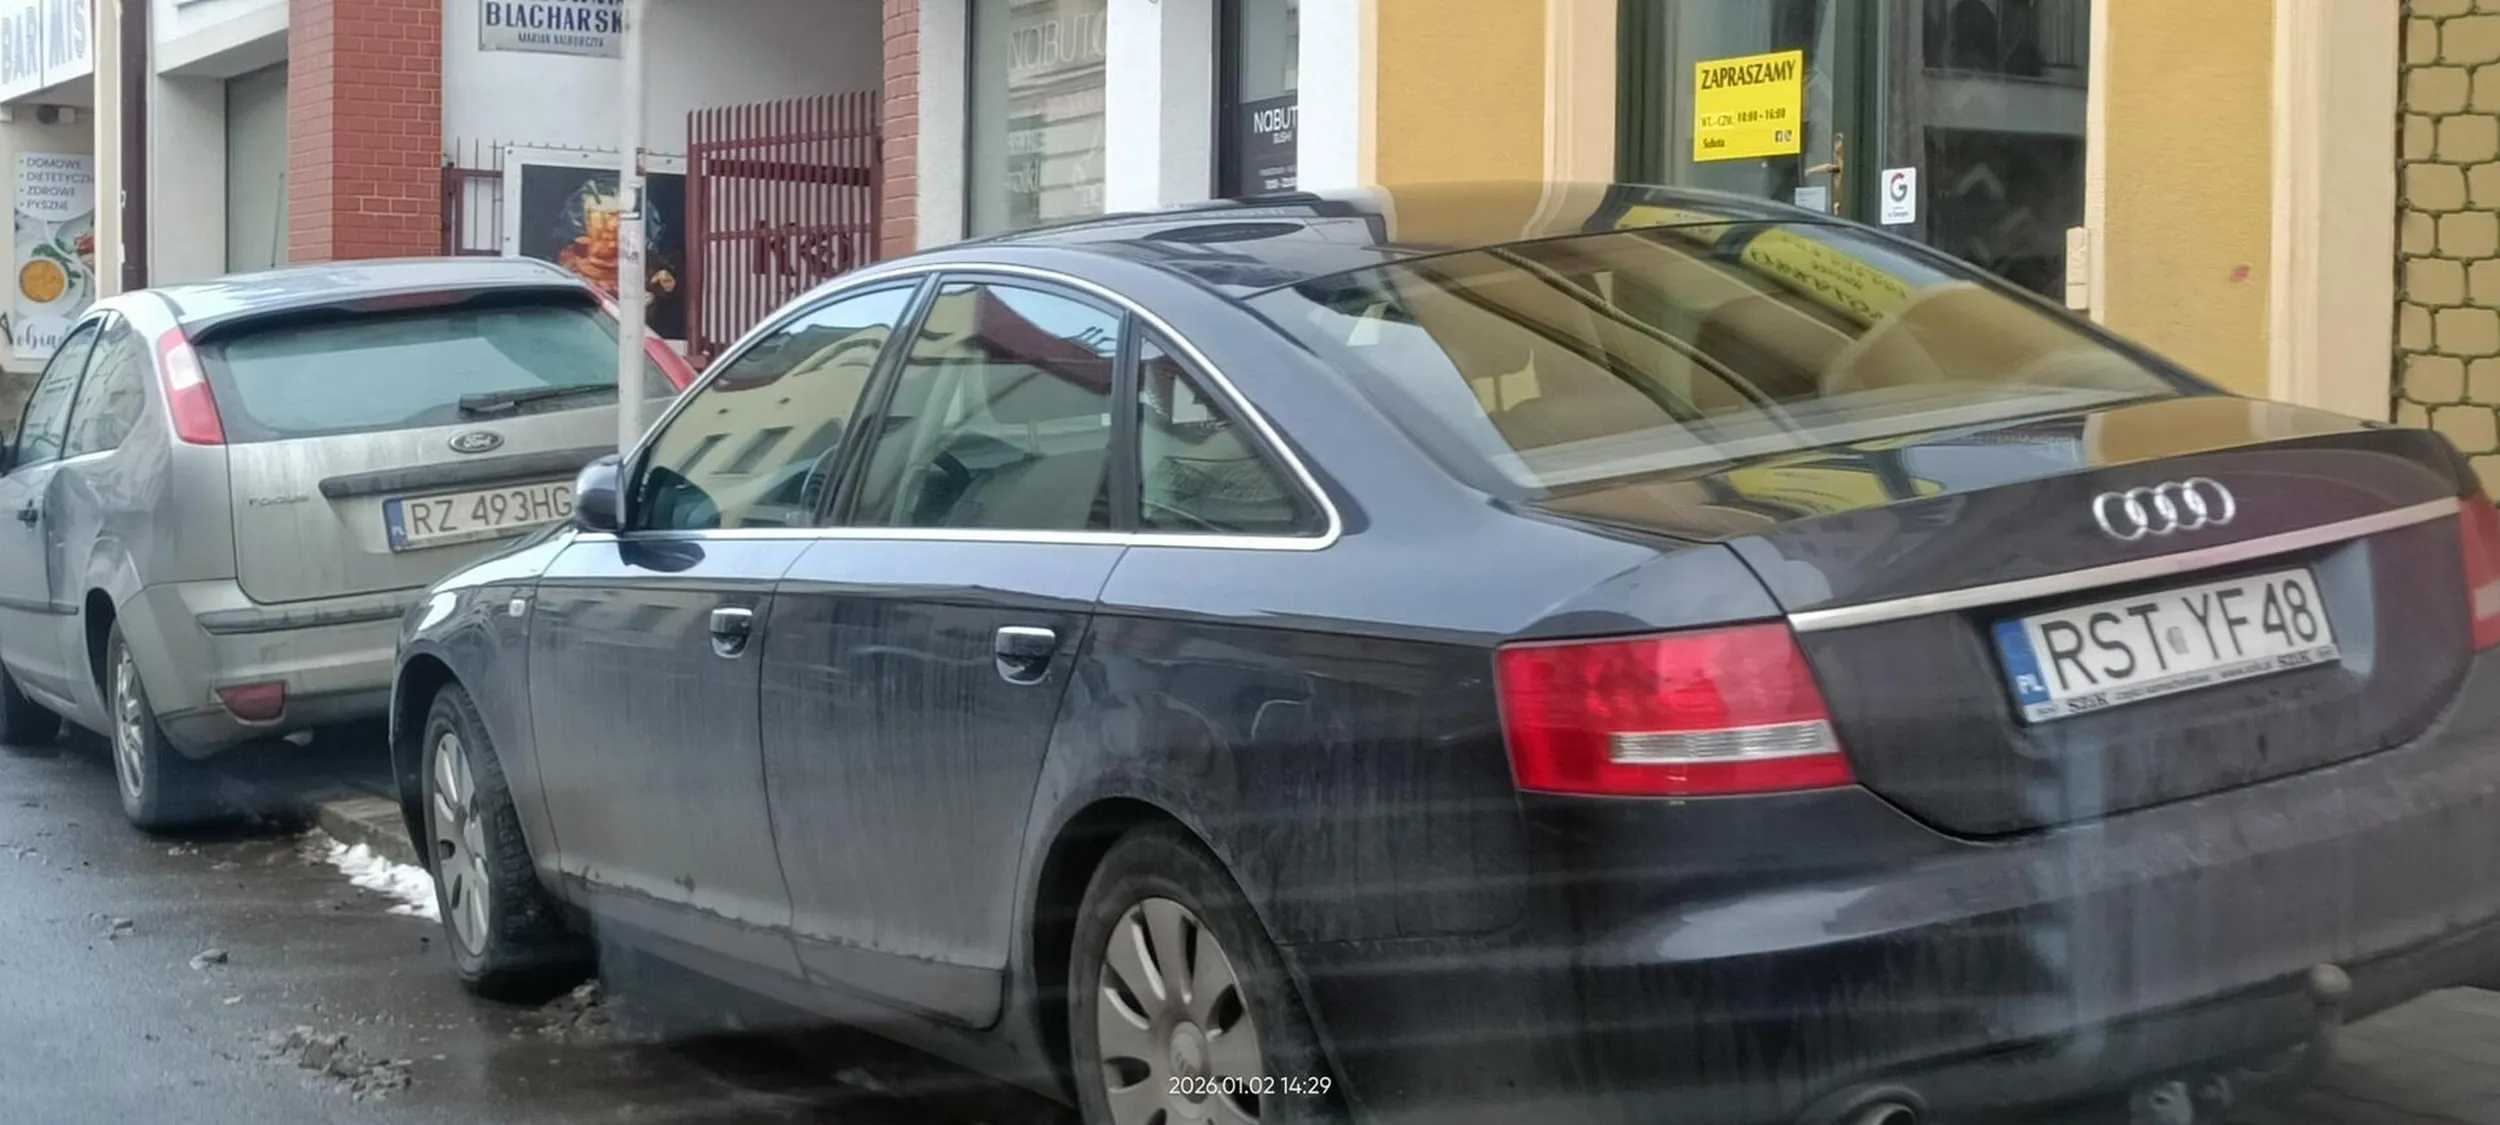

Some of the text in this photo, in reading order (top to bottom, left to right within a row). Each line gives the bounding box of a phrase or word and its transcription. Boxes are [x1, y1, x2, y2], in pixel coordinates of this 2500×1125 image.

[2, 6, 38, 84] BAR
[1701, 60, 1796, 90] ZAPRASZAMY
[27, 186, 75, 197] ZDROWE
[462, 434, 493, 449] Ford
[411, 487, 572, 535] RZ 493HG
[2040, 603, 2168, 691] RST
[2015, 673, 2045, 696] PL
